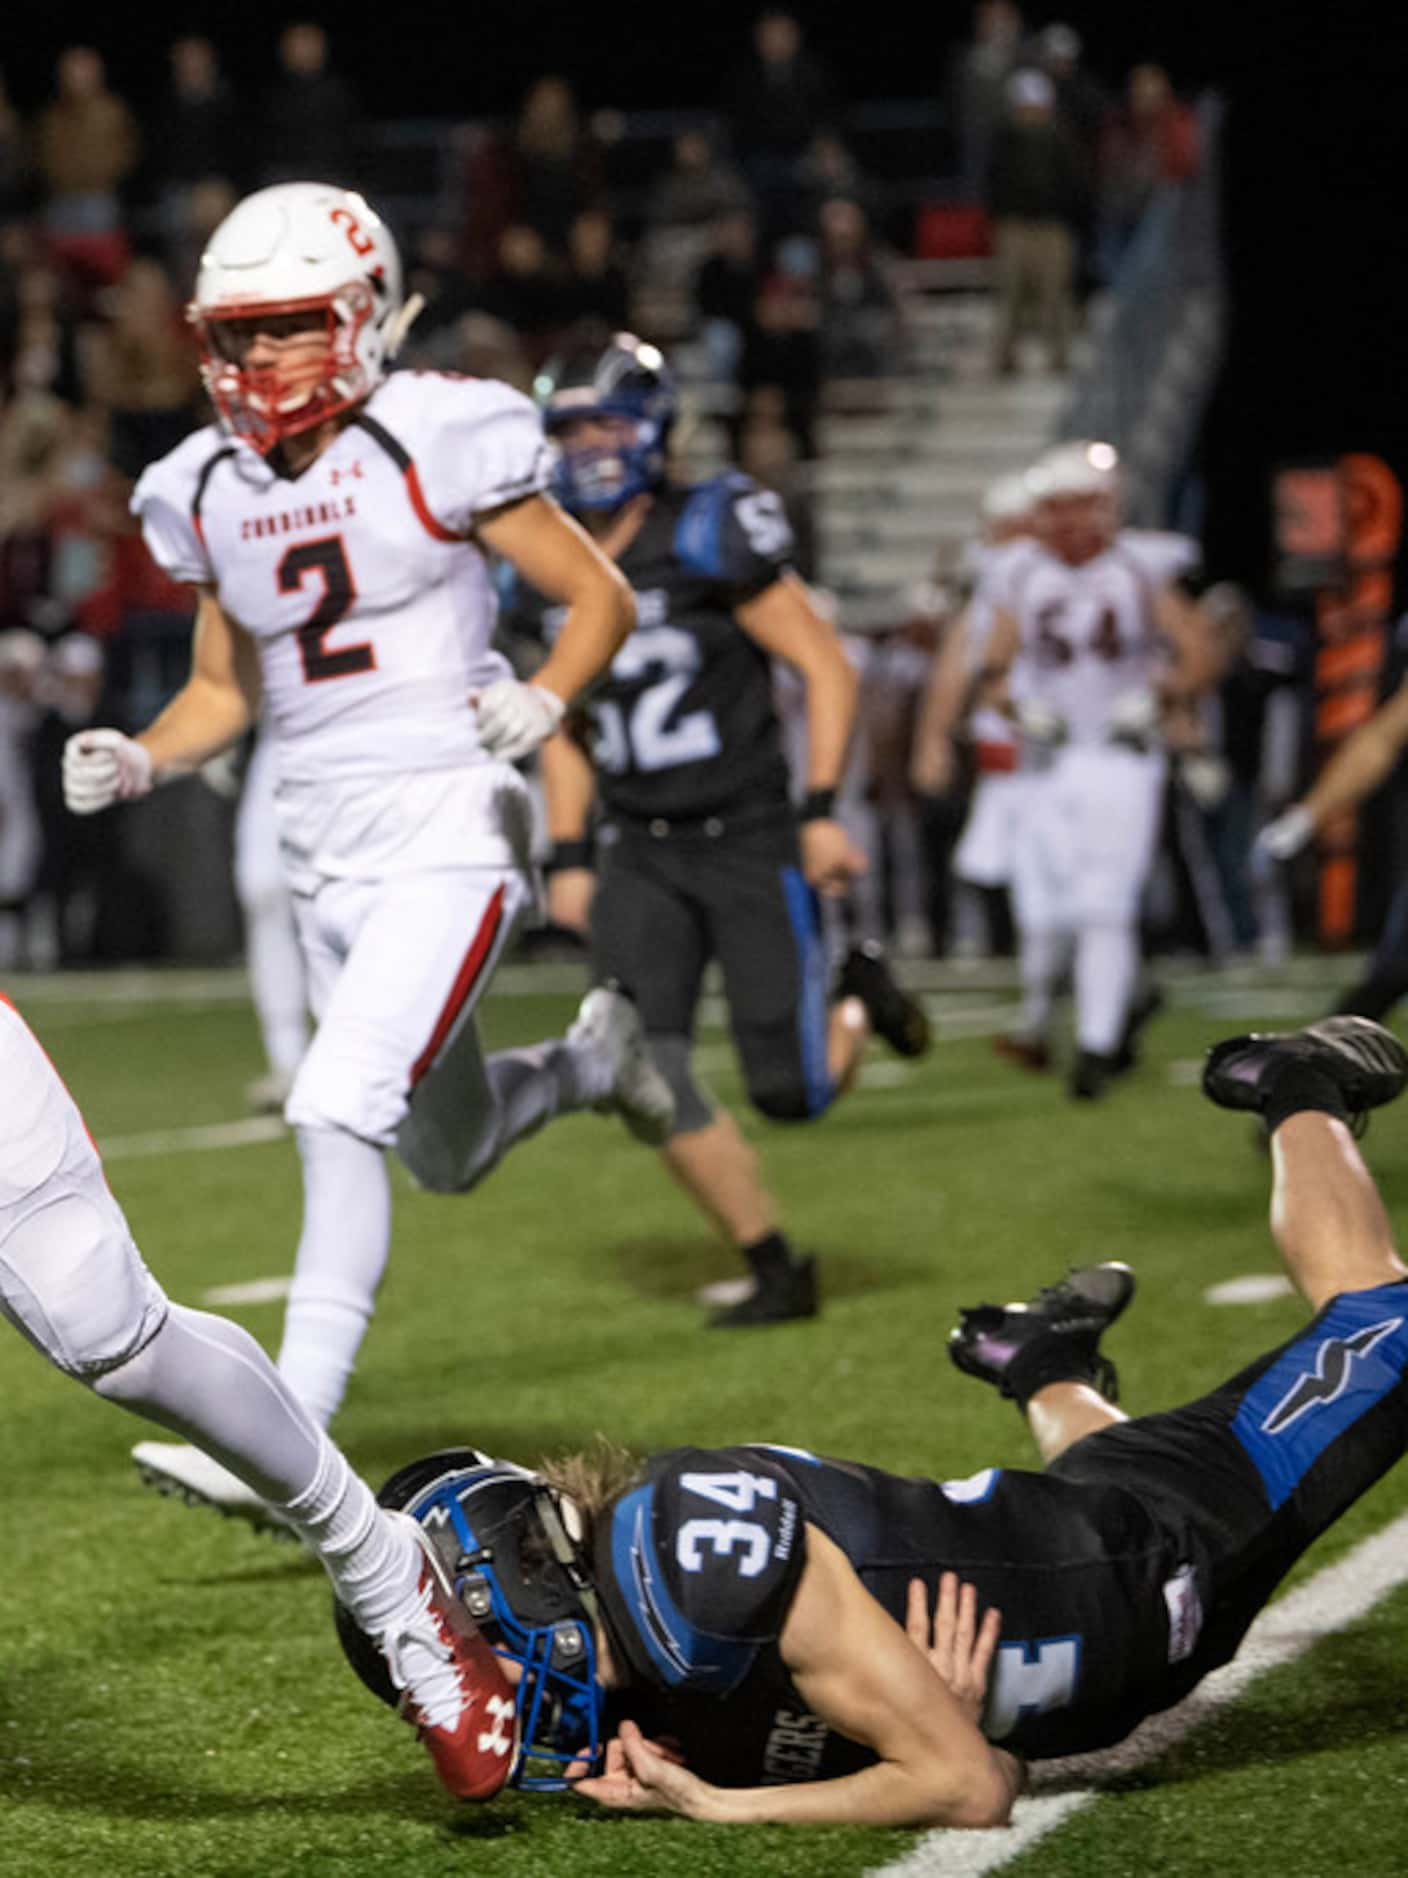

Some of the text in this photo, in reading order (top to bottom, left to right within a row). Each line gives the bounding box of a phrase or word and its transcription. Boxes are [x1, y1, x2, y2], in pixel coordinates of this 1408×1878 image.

[330, 208, 375, 256] 2
[274, 531, 379, 686] 2
[677, 1470, 778, 1577] 34
